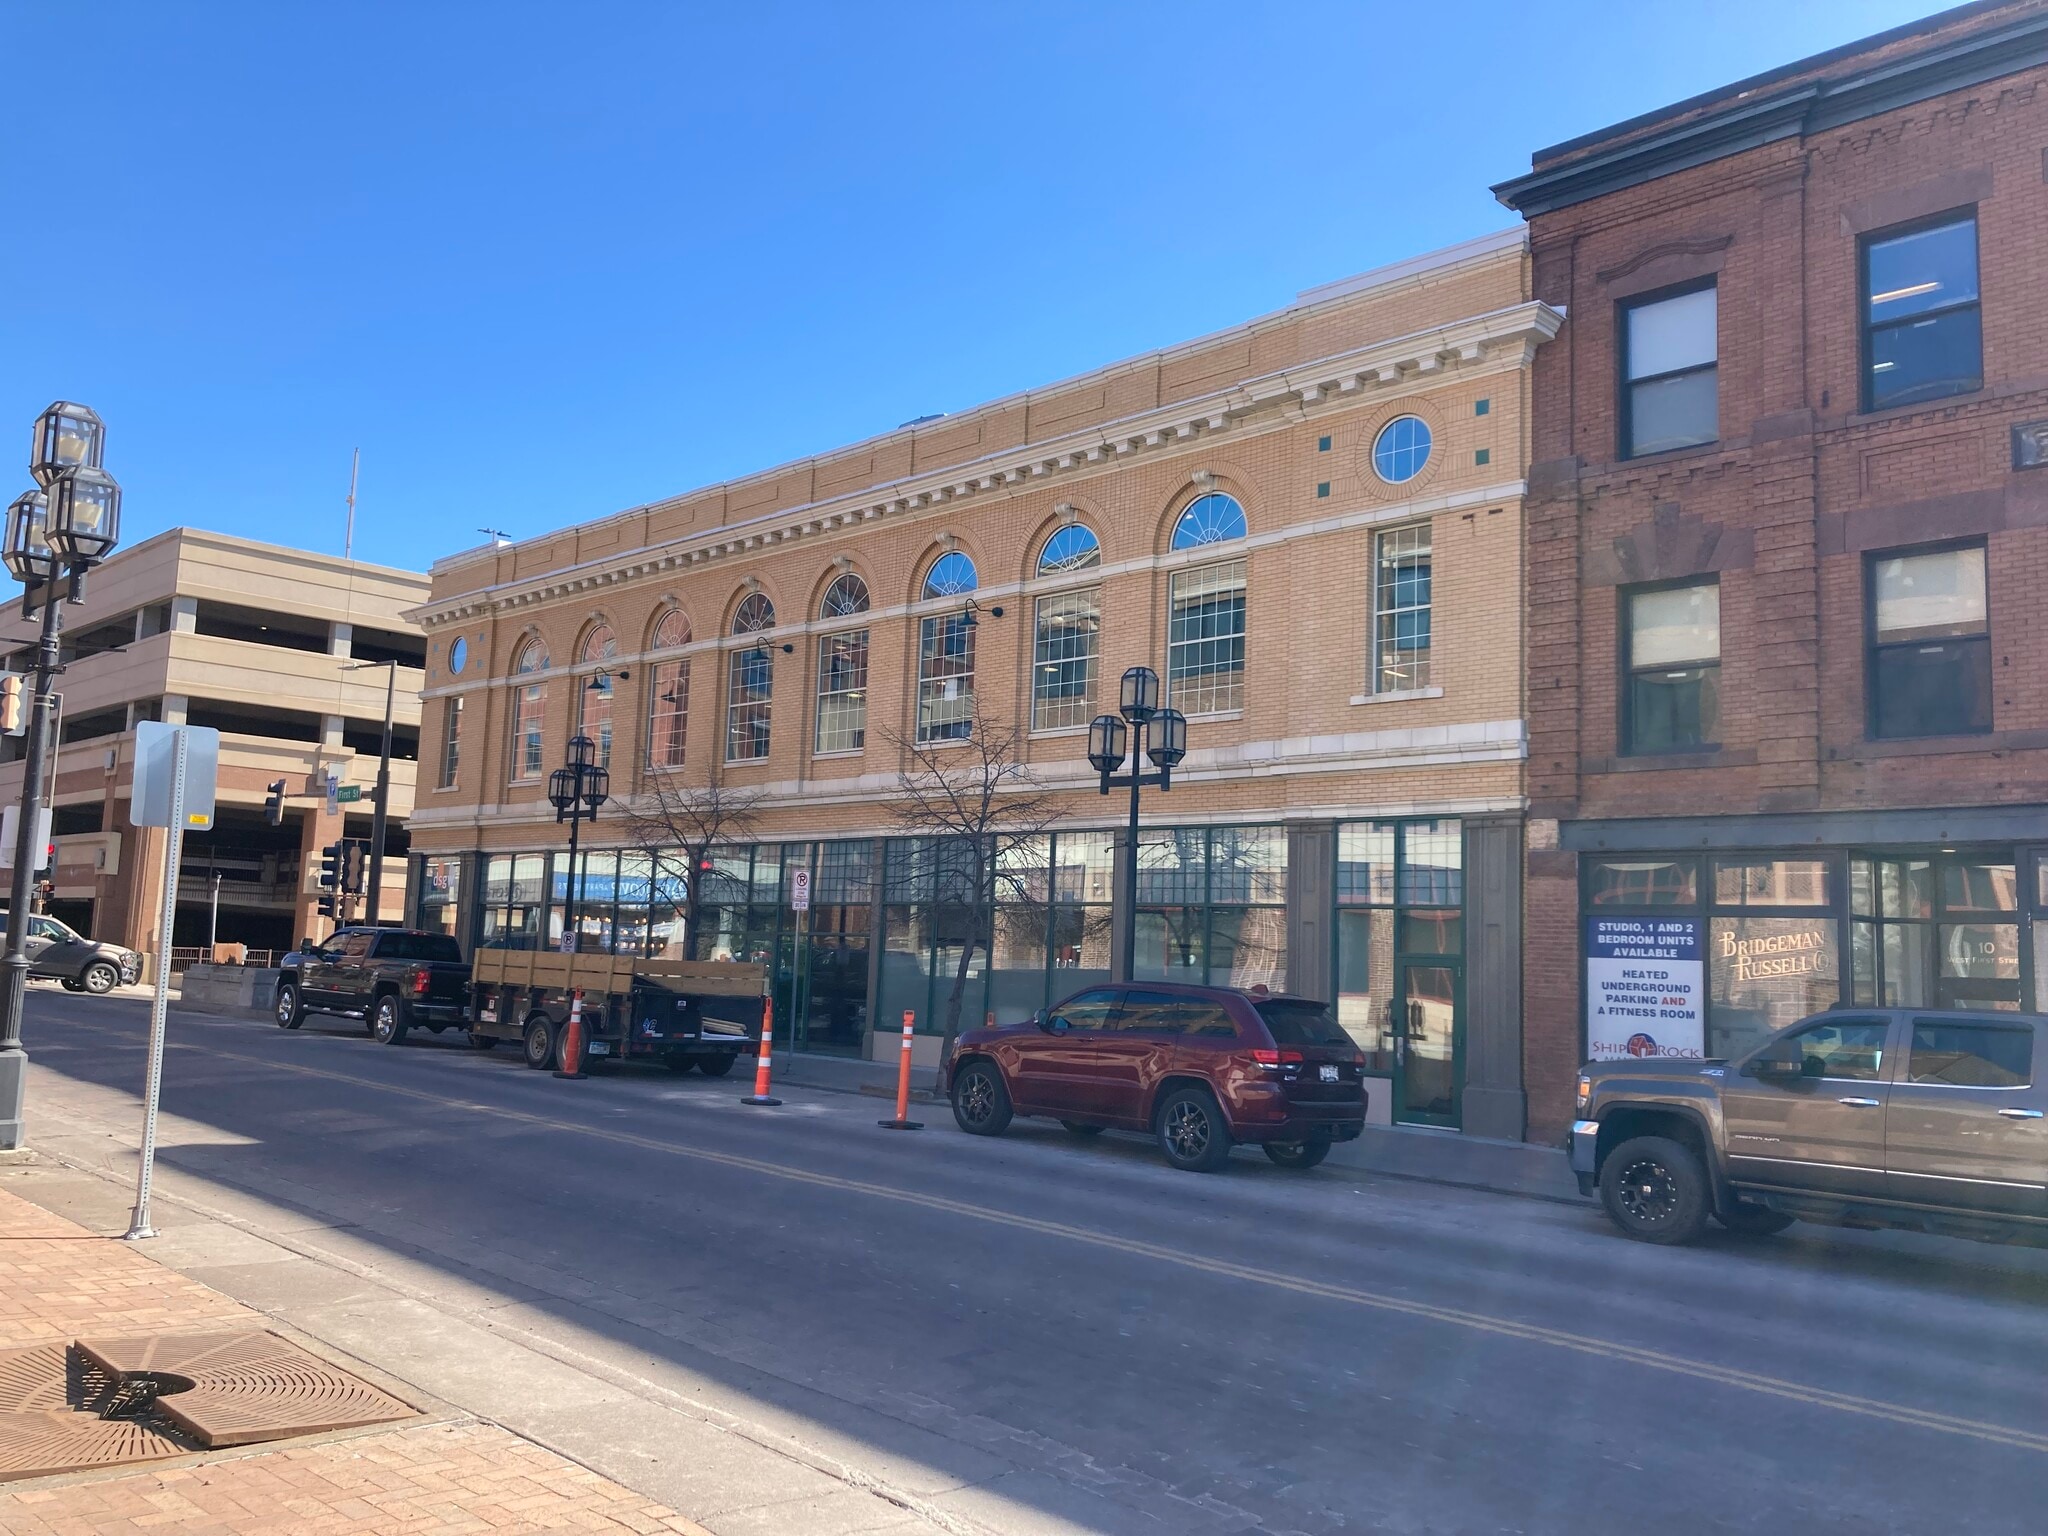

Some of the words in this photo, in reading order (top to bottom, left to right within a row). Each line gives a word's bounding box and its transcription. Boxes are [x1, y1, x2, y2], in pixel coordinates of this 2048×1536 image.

[338, 789, 351, 799] First
[352, 788, 359, 798] St
[1598, 922, 1645, 933] STUDIO,
[1648, 923, 1654, 932] 1
[1657, 923, 1683, 932] AND
[1686, 924, 1694, 933] 2
[1597, 934, 1655, 945] BEDROOM
[1657, 936, 1694, 946] UNITS
[1718, 931, 1825, 957] BRIDGEMAN
[1613, 947, 1678, 958] AVAILABLE
[1978, 942, 1995, 954] 10
[1998, 956, 2019, 964] STRE
[1730, 956, 1812, 981] RUSSELL
[1622, 970, 1669, 980] HEATED
[1601, 981, 1691, 993] UNDERGROUND
[1605, 994, 1658, 1005] PARKING
[1661, 996, 1686, 1006] AND
[1597, 1006, 1606, 1015] A
[1608, 1006, 1657, 1018] FITNESS
[1660, 1009, 1696, 1019] ROOM
[1592, 1041, 1627, 1054] SHIP
[1657, 1045, 1700, 1059] ROCK
